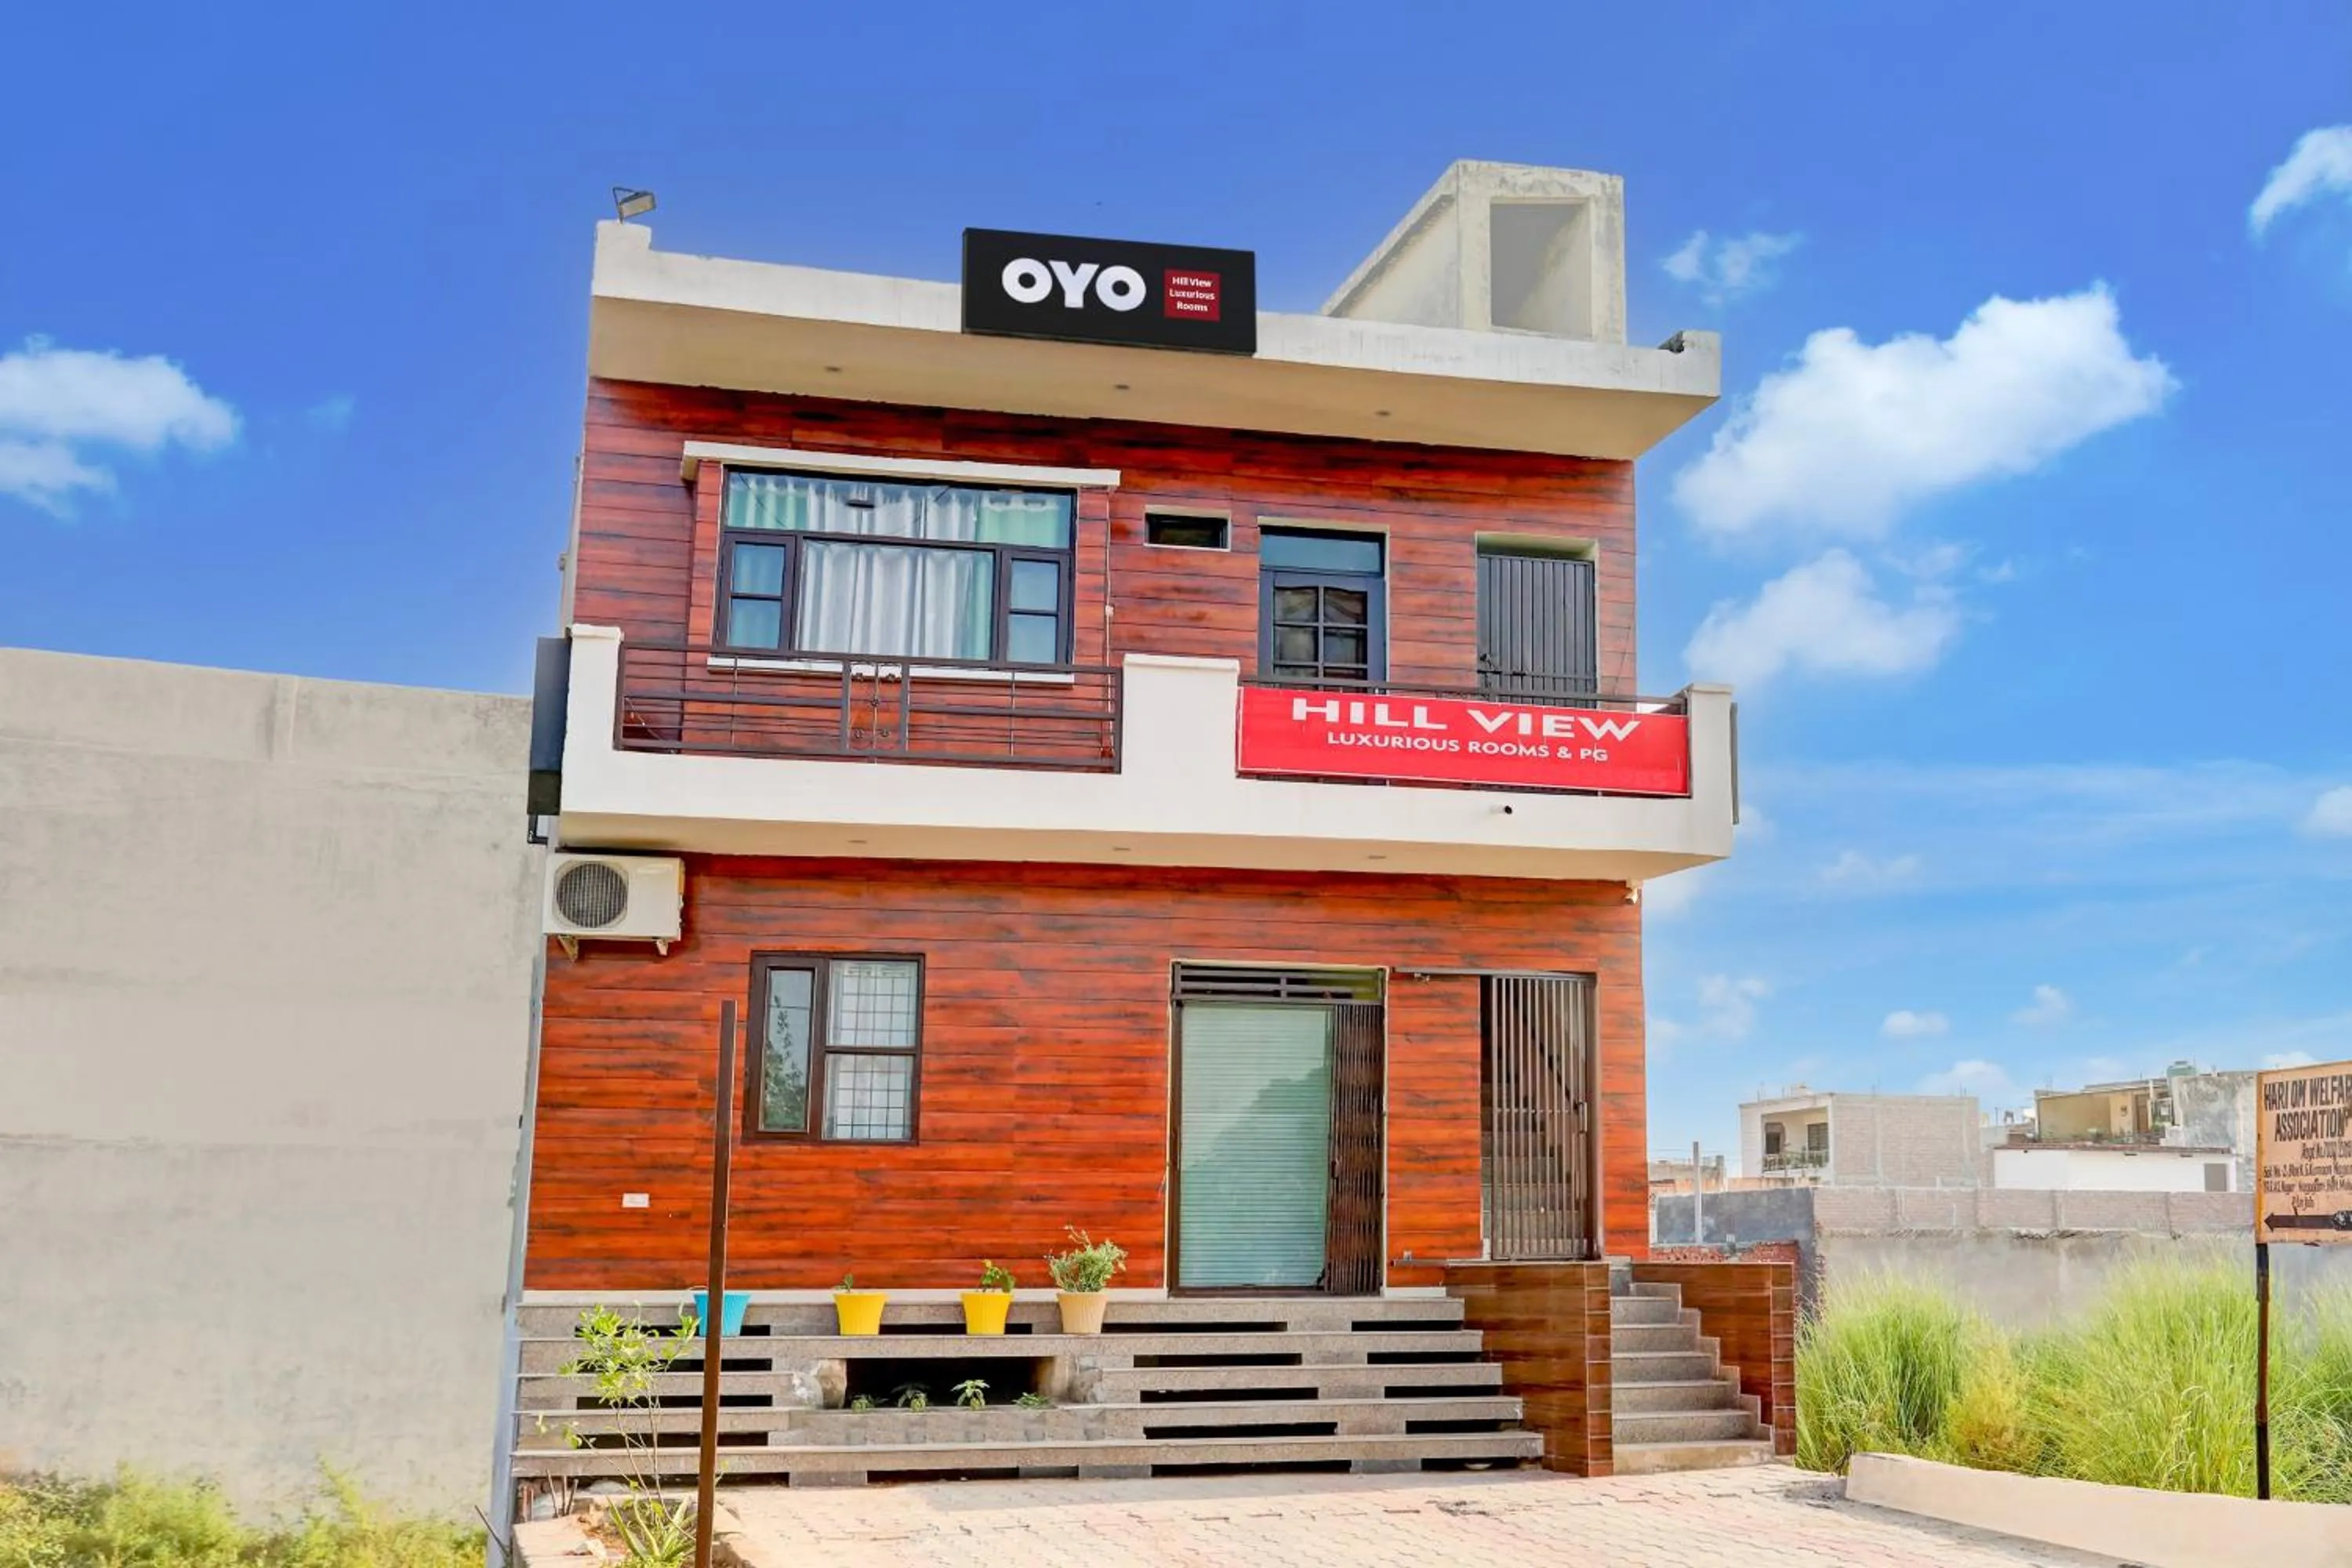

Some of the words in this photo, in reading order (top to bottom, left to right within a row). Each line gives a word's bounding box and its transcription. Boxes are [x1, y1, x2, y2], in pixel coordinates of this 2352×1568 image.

[1002, 258, 1146, 311] OYO
[1169, 288, 1215, 300] Luxurious
[1172, 277, 1189, 285] Hill
[1189, 278, 1212, 288] View
[1177, 301, 1208, 311] Rooms
[1292, 698, 1447, 730] HILL
[1467, 709, 1641, 741] VIEW
[1327, 731, 1460, 753] LUXURIOUS
[1468, 740, 1550, 757] ROOMS
[1556, 746, 1572, 759] &
[1580, 747, 1608, 761] PG
[2264, 1081, 2288, 1111] HARI
[2291, 1079, 2307, 1108] OM
[2275, 1108, 2345, 1142] ASSOCIATION
